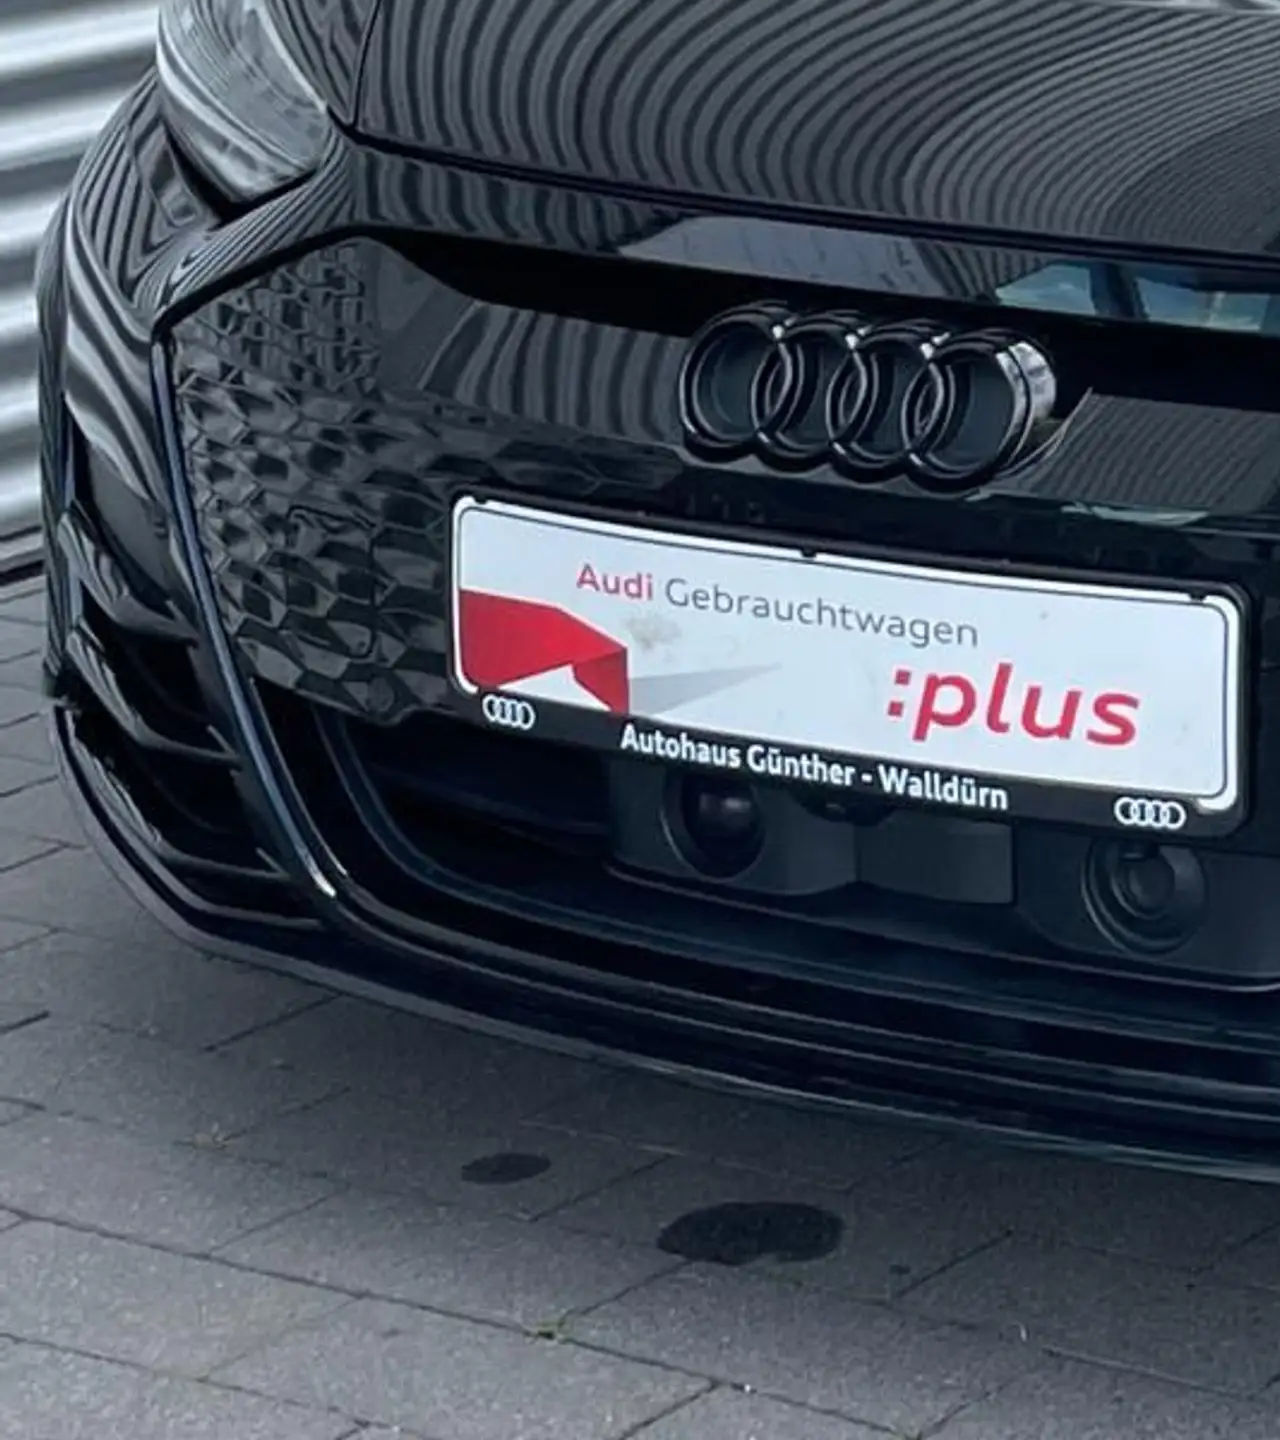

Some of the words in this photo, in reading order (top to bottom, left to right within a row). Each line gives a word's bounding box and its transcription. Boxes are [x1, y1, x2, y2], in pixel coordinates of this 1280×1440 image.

[576, 563, 655, 600] Audi
[665, 578, 979, 648] Gebrauchtwagen
[887, 662, 1139, 746] :plus
[620, 722, 741, 769] Autohaus
[746, 743, 855, 787] Günther
[878, 764, 1009, 812] Walldürn
